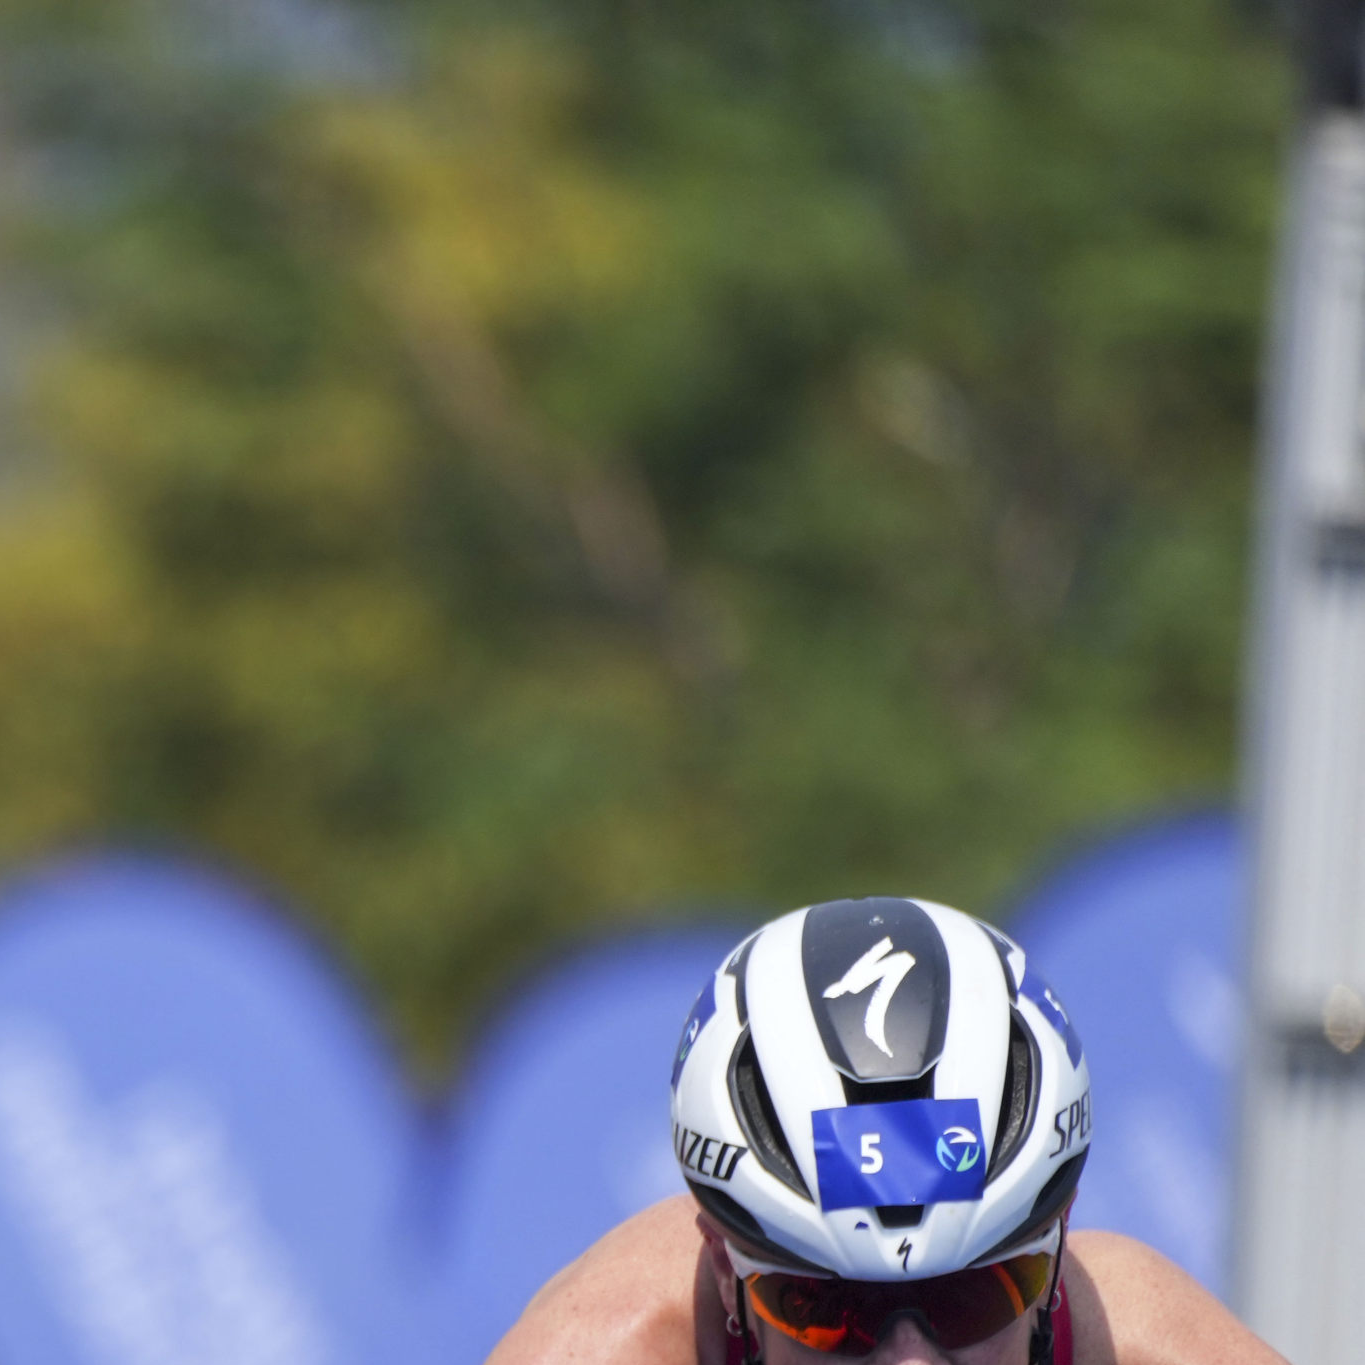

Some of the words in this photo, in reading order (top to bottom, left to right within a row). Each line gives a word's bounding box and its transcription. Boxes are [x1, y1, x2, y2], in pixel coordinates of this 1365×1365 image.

[674, 1122, 748, 1182] IZED
[860, 1132, 884, 1174] 5
[1049, 1087, 1092, 1160] SPE
